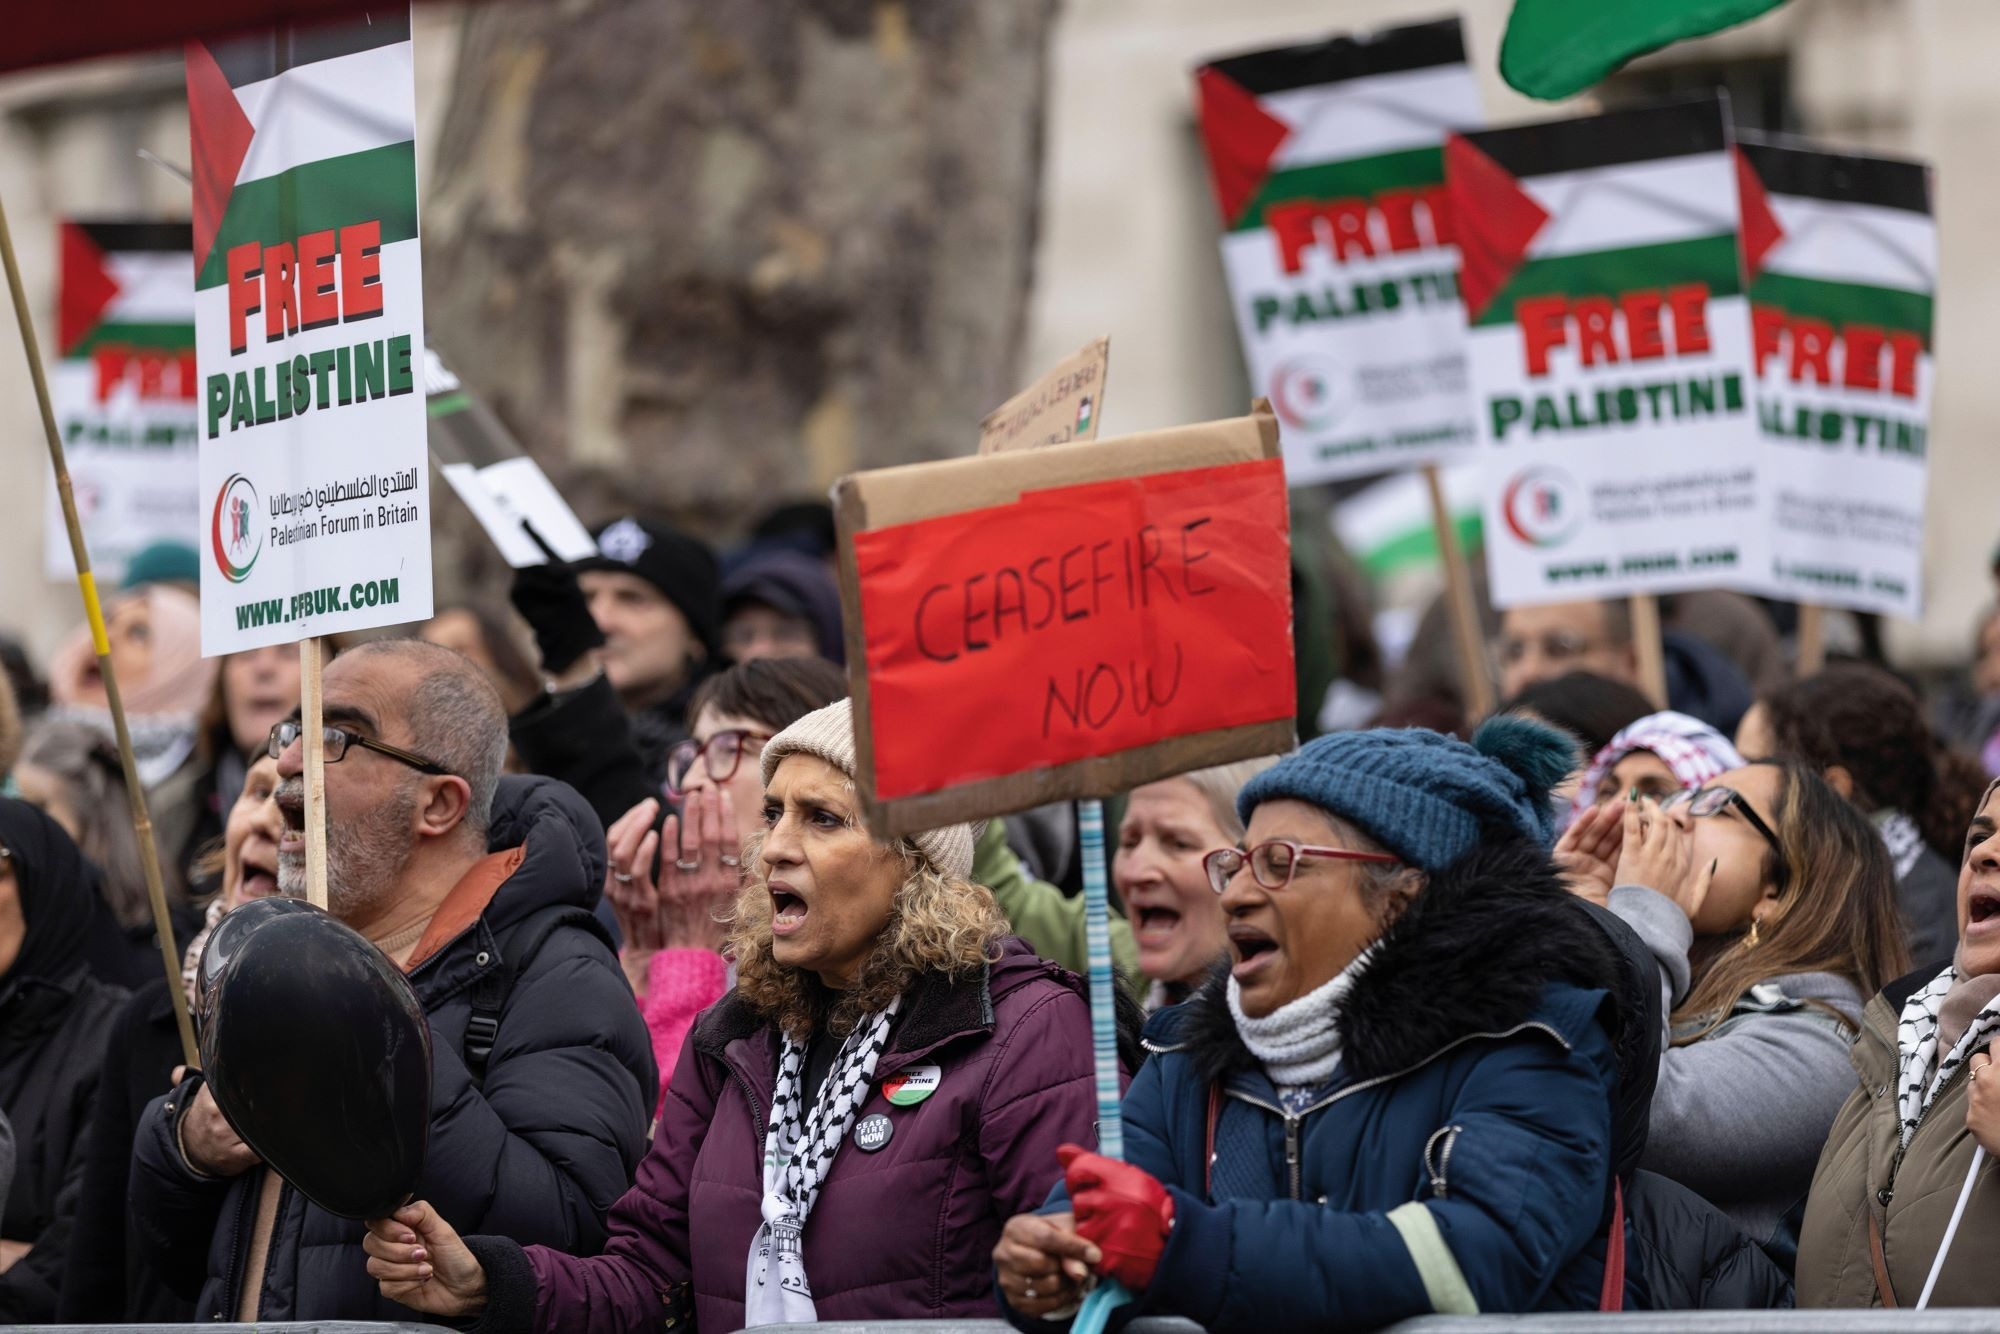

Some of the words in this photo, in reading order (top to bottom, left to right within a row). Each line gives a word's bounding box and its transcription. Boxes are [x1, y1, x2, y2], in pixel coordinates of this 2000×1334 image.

[226, 218, 384, 358] FREE
[1516, 282, 1713, 378] FREE
[1751, 304, 1924, 400] FREE
[206, 333, 414, 440] PALESTINE
[1490, 373, 1743, 440] PALESTINE
[315, 474, 377, 512] الفلسطيني
[378, 467, 418, 498] المنتدى
[270, 518, 318, 548] Palestinian
[321, 513, 360, 536] Forum
[363, 508, 374, 530] in
[378, 501, 418, 527] Britain
[235, 577, 400, 631] WWW.PFBUK.COM
[914, 516, 1217, 663] CEASEFIRE
[1042, 641, 1182, 739] NOW
[855, 1117, 888, 1130] CEASE
[860, 1124, 885, 1135] FIRE
[860, 1131, 885, 1145] NOW
